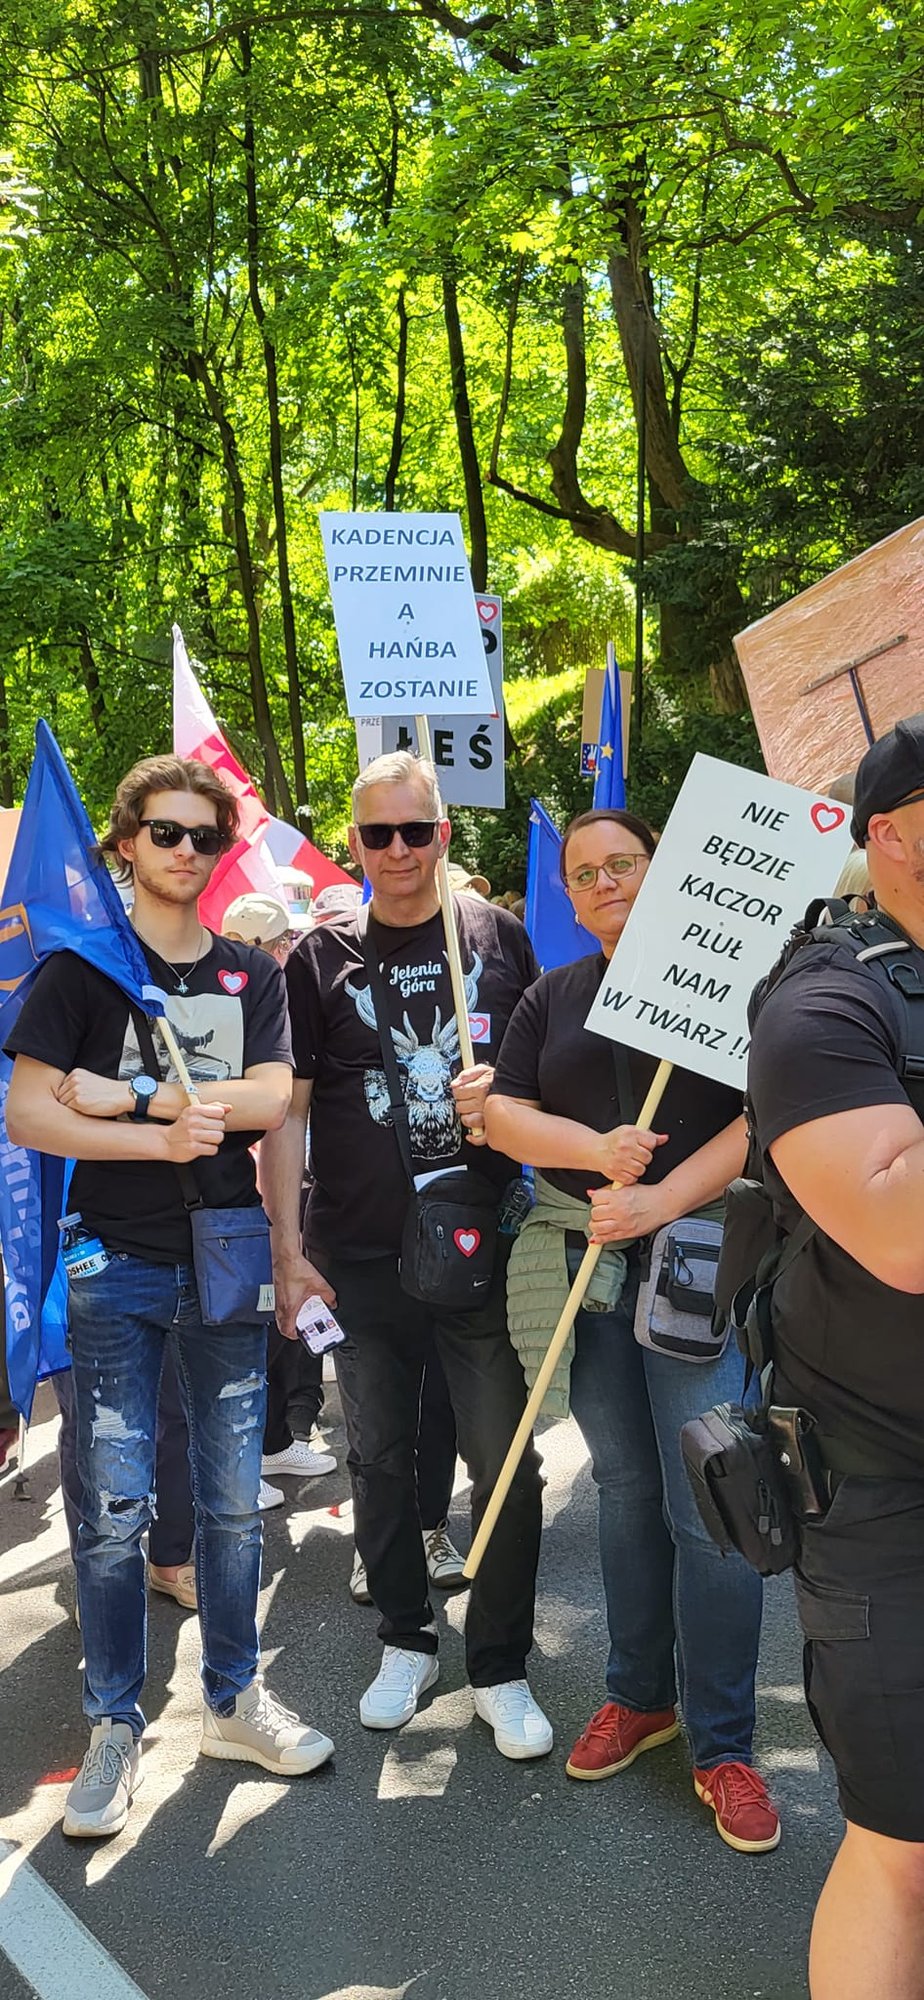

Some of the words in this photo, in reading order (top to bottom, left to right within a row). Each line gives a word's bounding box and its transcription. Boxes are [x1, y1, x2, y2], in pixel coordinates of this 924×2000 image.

[331, 529, 455, 546] KADENCJA
[333, 565, 466, 583] PRZEMINIE
[368, 636, 457, 659] HAŃBA
[359, 679, 478, 699] ZOSTANIE
[741, 801, 790, 832] NIE
[702, 835, 795, 882] BĘDZIE
[678, 873, 784, 926] KACZOR
[681, 922, 745, 961] PLUŁ
[389, 960, 442, 986] Jelenia
[662, 963, 732, 1003] NAM
[399, 977, 436, 998] Góra
[601, 986, 634, 1012] W
[635, 999, 728, 1051] TWARZ
